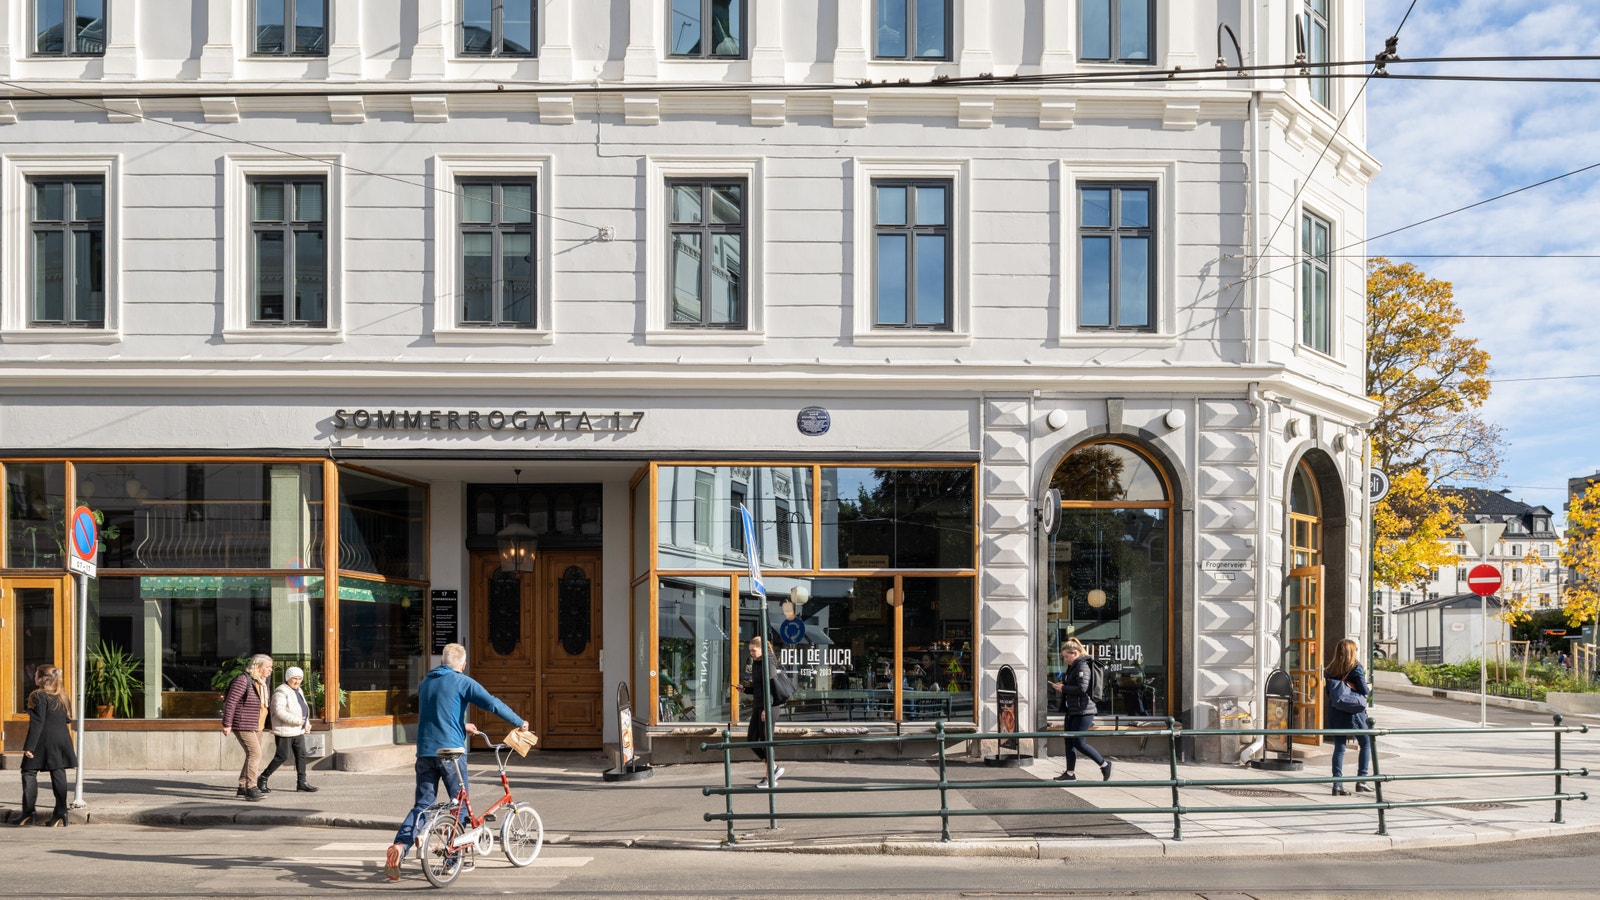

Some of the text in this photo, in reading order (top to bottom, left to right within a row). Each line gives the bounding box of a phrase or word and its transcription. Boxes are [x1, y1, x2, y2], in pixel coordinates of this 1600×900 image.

[334, 409, 645, 431] SOMMERROGATA 17
[780, 648, 852, 666] DELI DE LUCA
[1098, 644, 1112, 657] DE
[1114, 644, 1142, 661] LUCA
